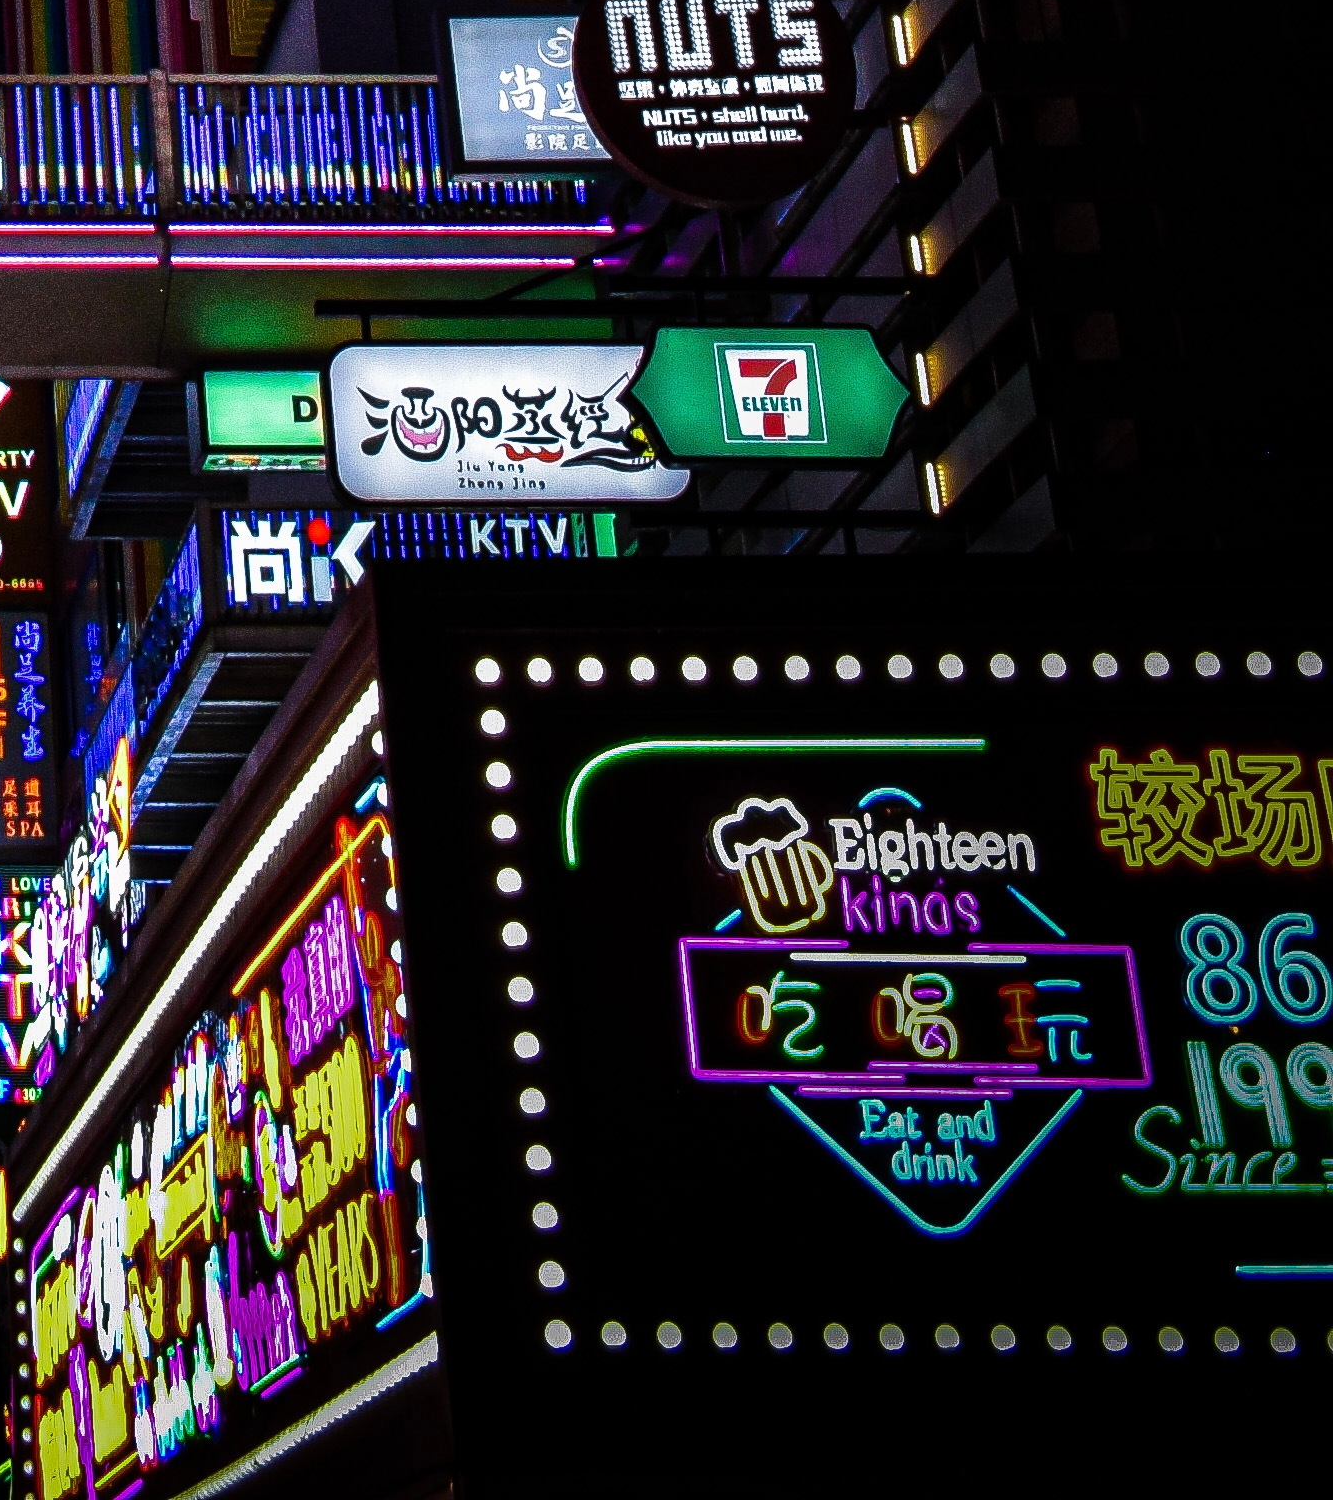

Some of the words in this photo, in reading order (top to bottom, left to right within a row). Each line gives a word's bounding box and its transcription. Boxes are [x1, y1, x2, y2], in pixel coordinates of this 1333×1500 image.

[713, 105, 757, 123] shell
[656, 130, 692, 147] like
[695, 131, 730, 149] you
[733, 129, 768, 144] and
[470, 519, 568, 557] KTV
[5, 820, 45, 838] SPA
[831, 816, 1036, 878] Eighteen
[12, 876, 51, 893] LOVE
[860, 1101, 921, 1140] Eat
[937, 1101, 995, 1141] and
[891, 1141, 978, 1182] drink
[1122, 1106, 1296, 1195] Since
